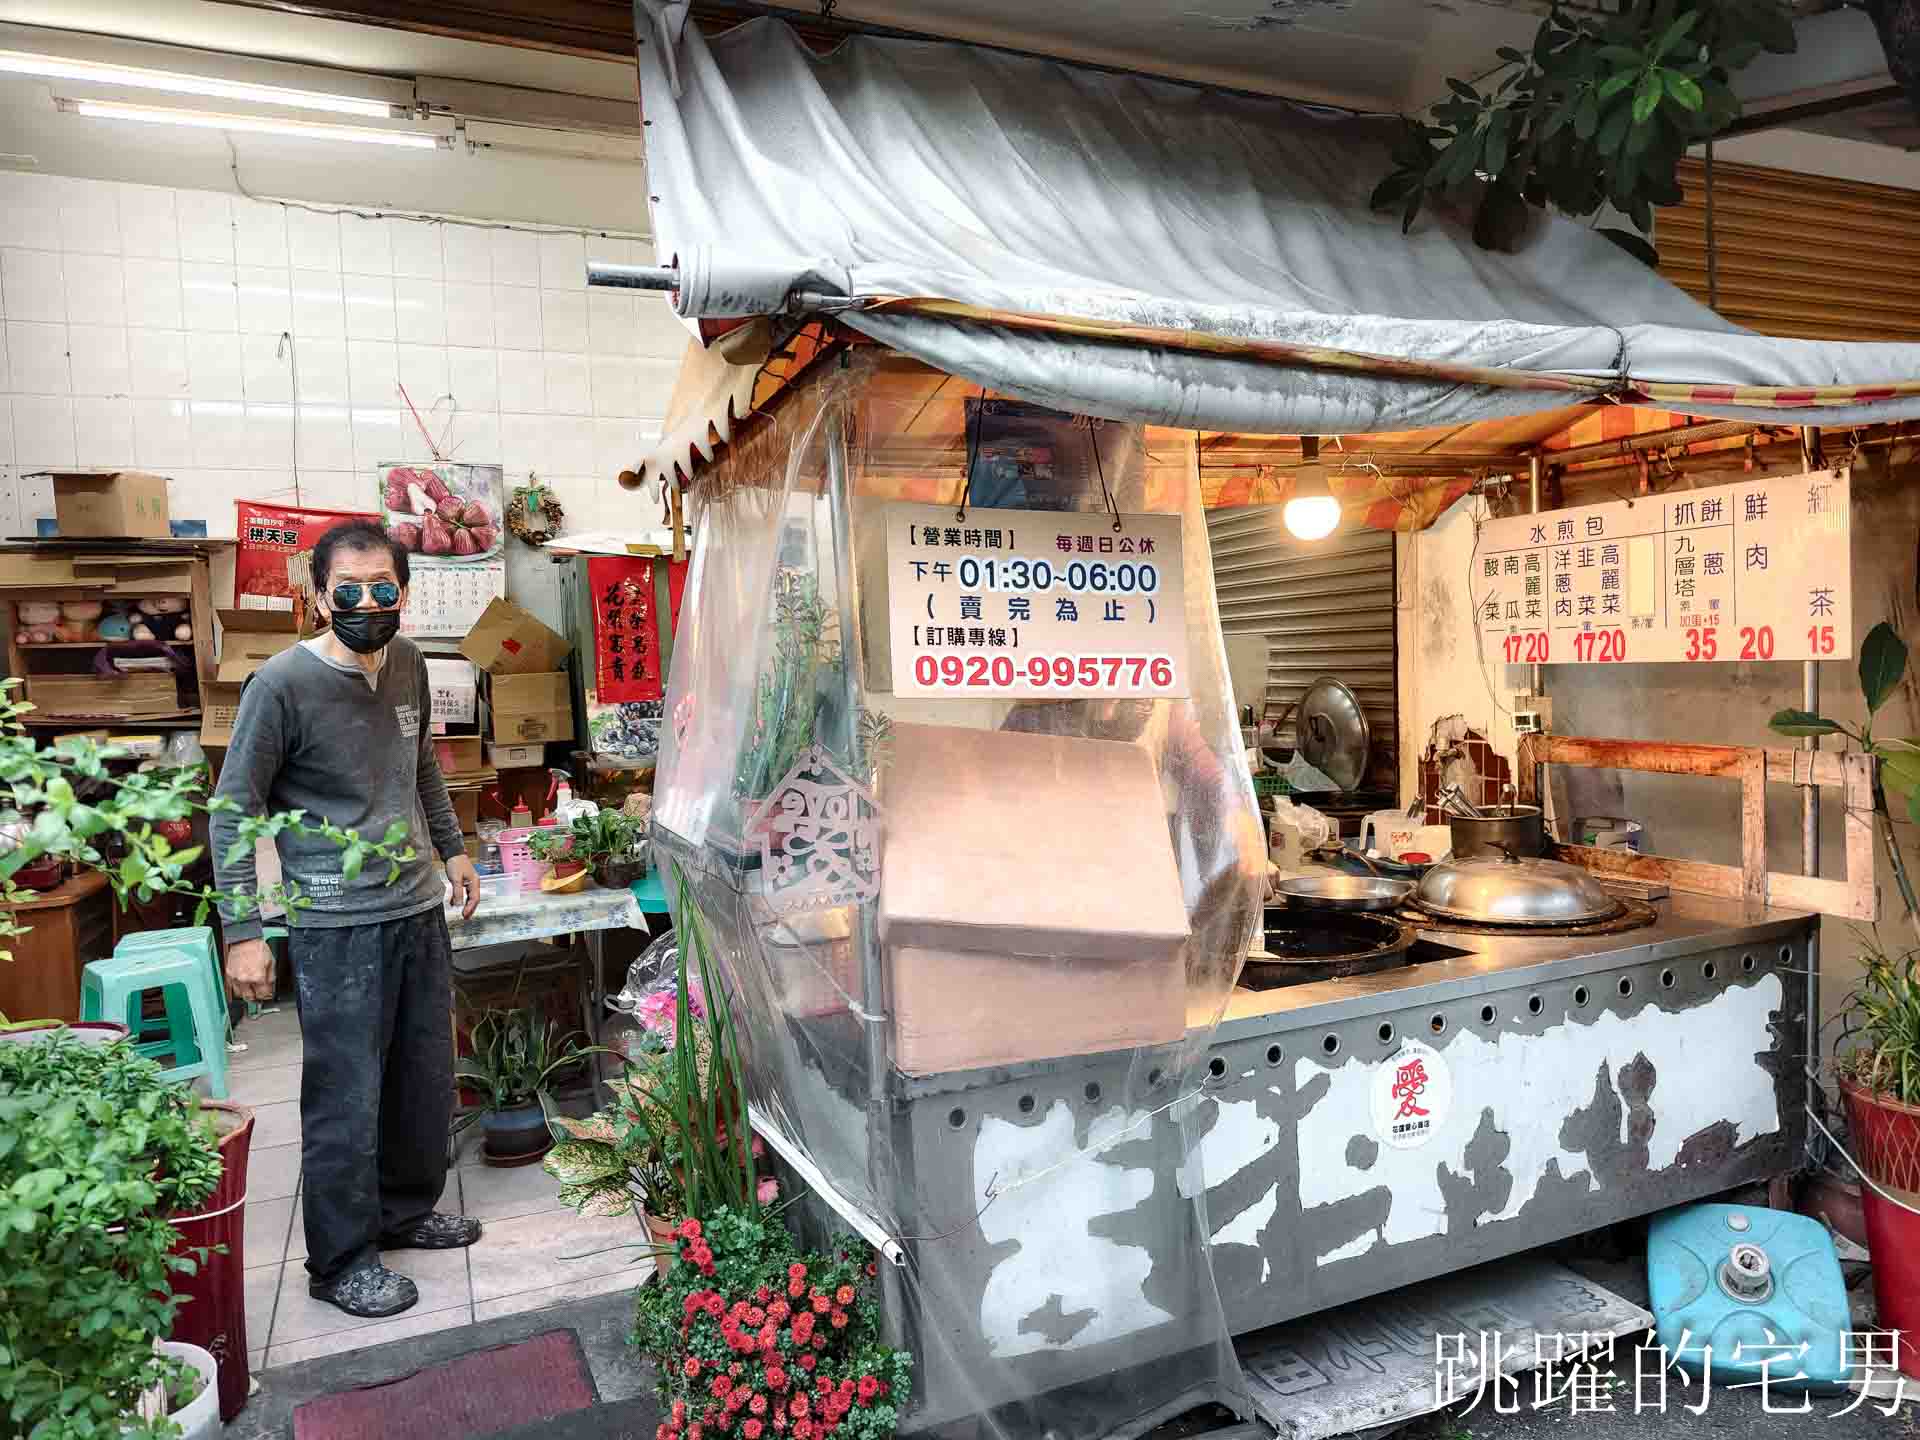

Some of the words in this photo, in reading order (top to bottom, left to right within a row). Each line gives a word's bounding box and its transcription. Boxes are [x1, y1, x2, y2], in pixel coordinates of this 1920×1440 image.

[1675, 497, 1722, 526] 抓餅
[909, 525, 1016, 550] 【營業時間】
[1056, 535, 1155, 553] 每週日公休
[1531, 517, 1604, 544] 水煎包
[1745, 492, 1768, 571] 鮮肉
[909, 561, 953, 582] 下午
[959, 559, 1157, 592] 01:30~06:00
[1601, 544, 1621, 615] 高麗菜
[1674, 536, 1696, 597] 九層塔
[1504, 556, 1520, 620] 南瓜
[1524, 553, 1542, 618] 高麗菜
[912, 626, 1019, 648] 【訂購專線】
[1686, 627, 1717, 660] 35
[1740, 625, 1774, 660] 20
[1807, 625, 1835, 654] 15
[914, 655, 1173, 687] 0920-995776
